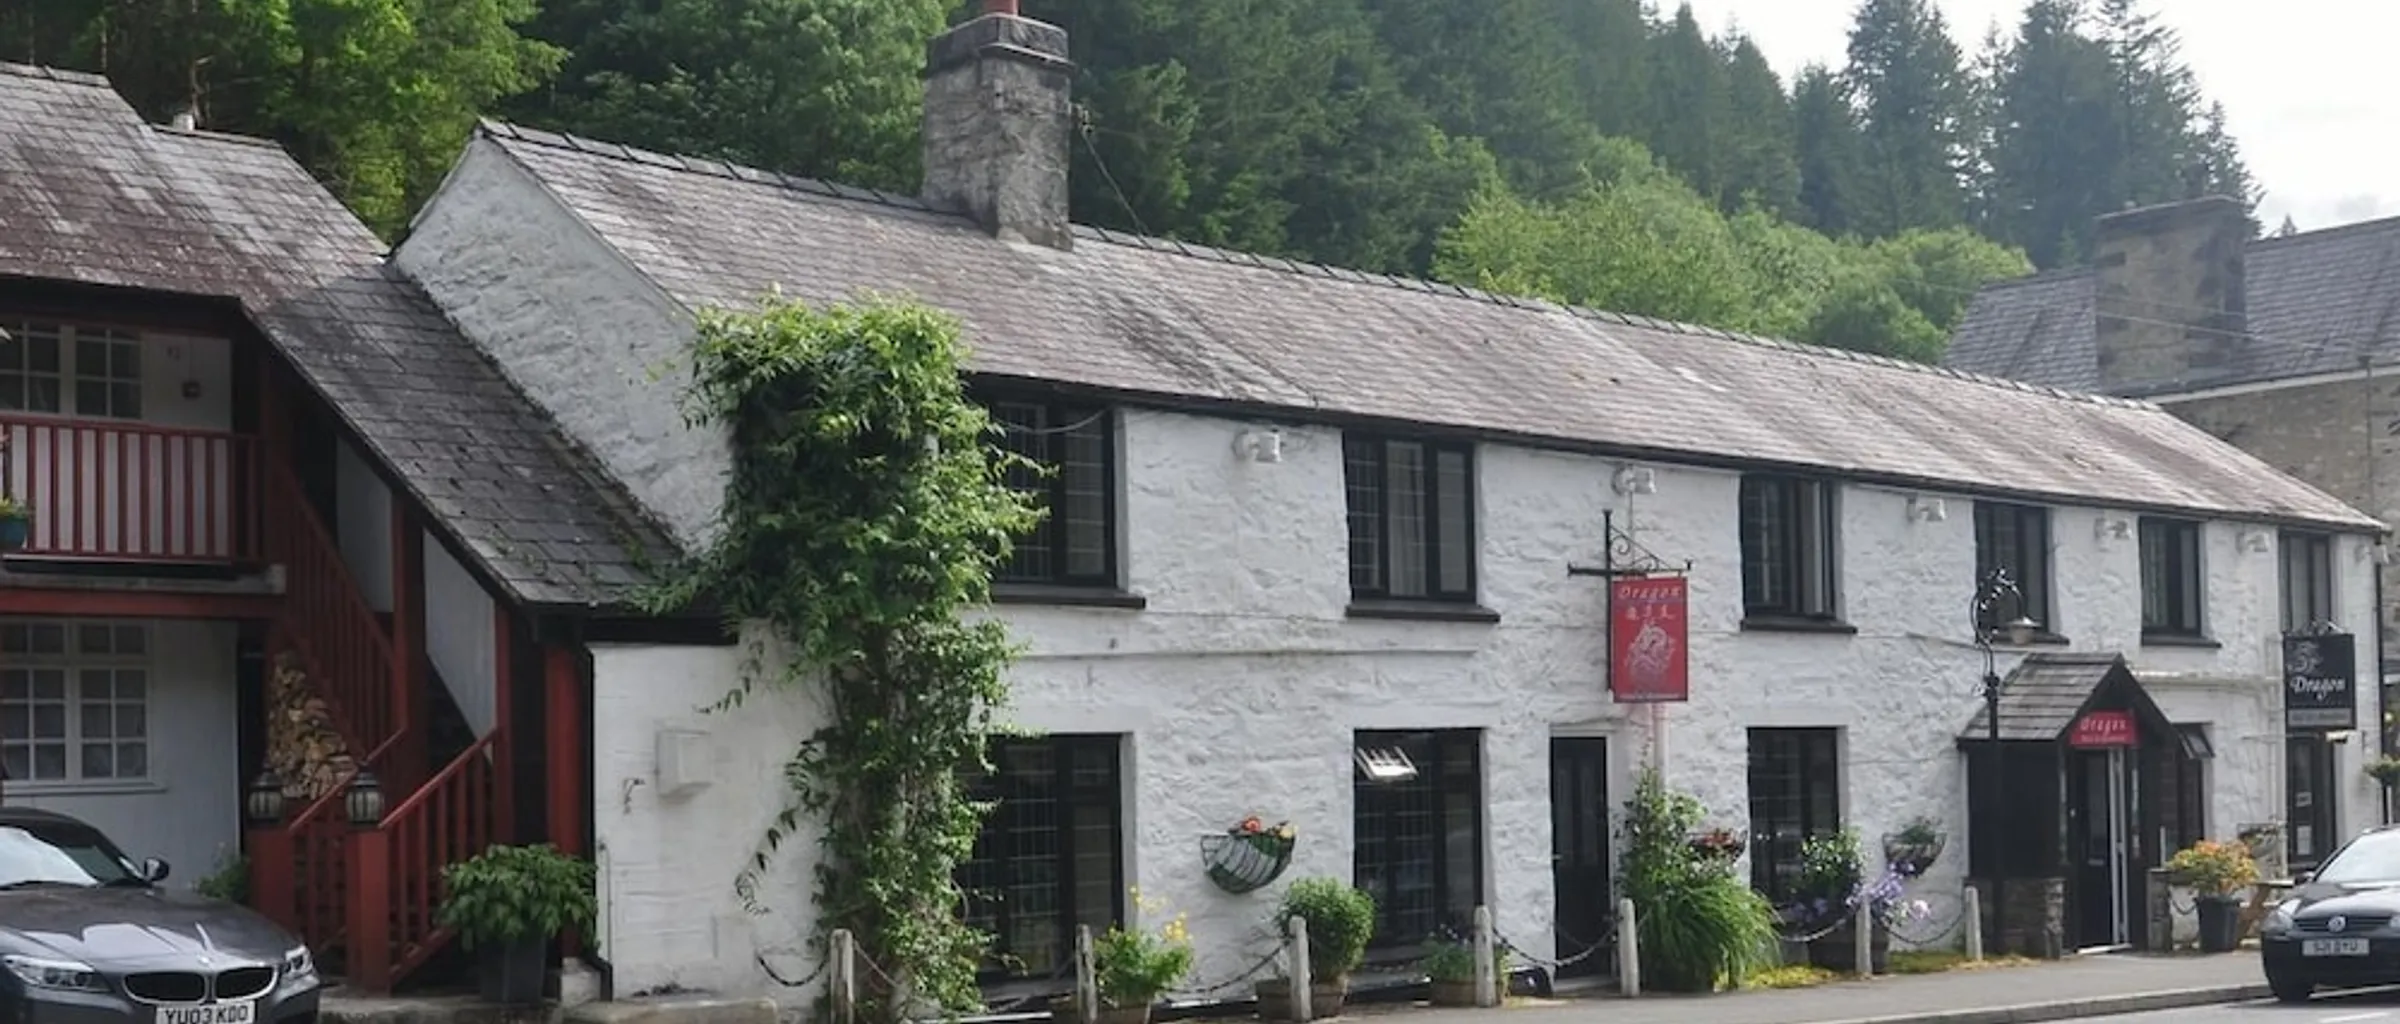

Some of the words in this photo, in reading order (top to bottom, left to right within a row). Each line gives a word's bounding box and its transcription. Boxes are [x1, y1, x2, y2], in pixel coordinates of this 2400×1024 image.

[1618, 586, 1682, 603] Dragon
[2290, 676, 2346, 701] Dragon
[2080, 716, 2127, 737] Dragon
